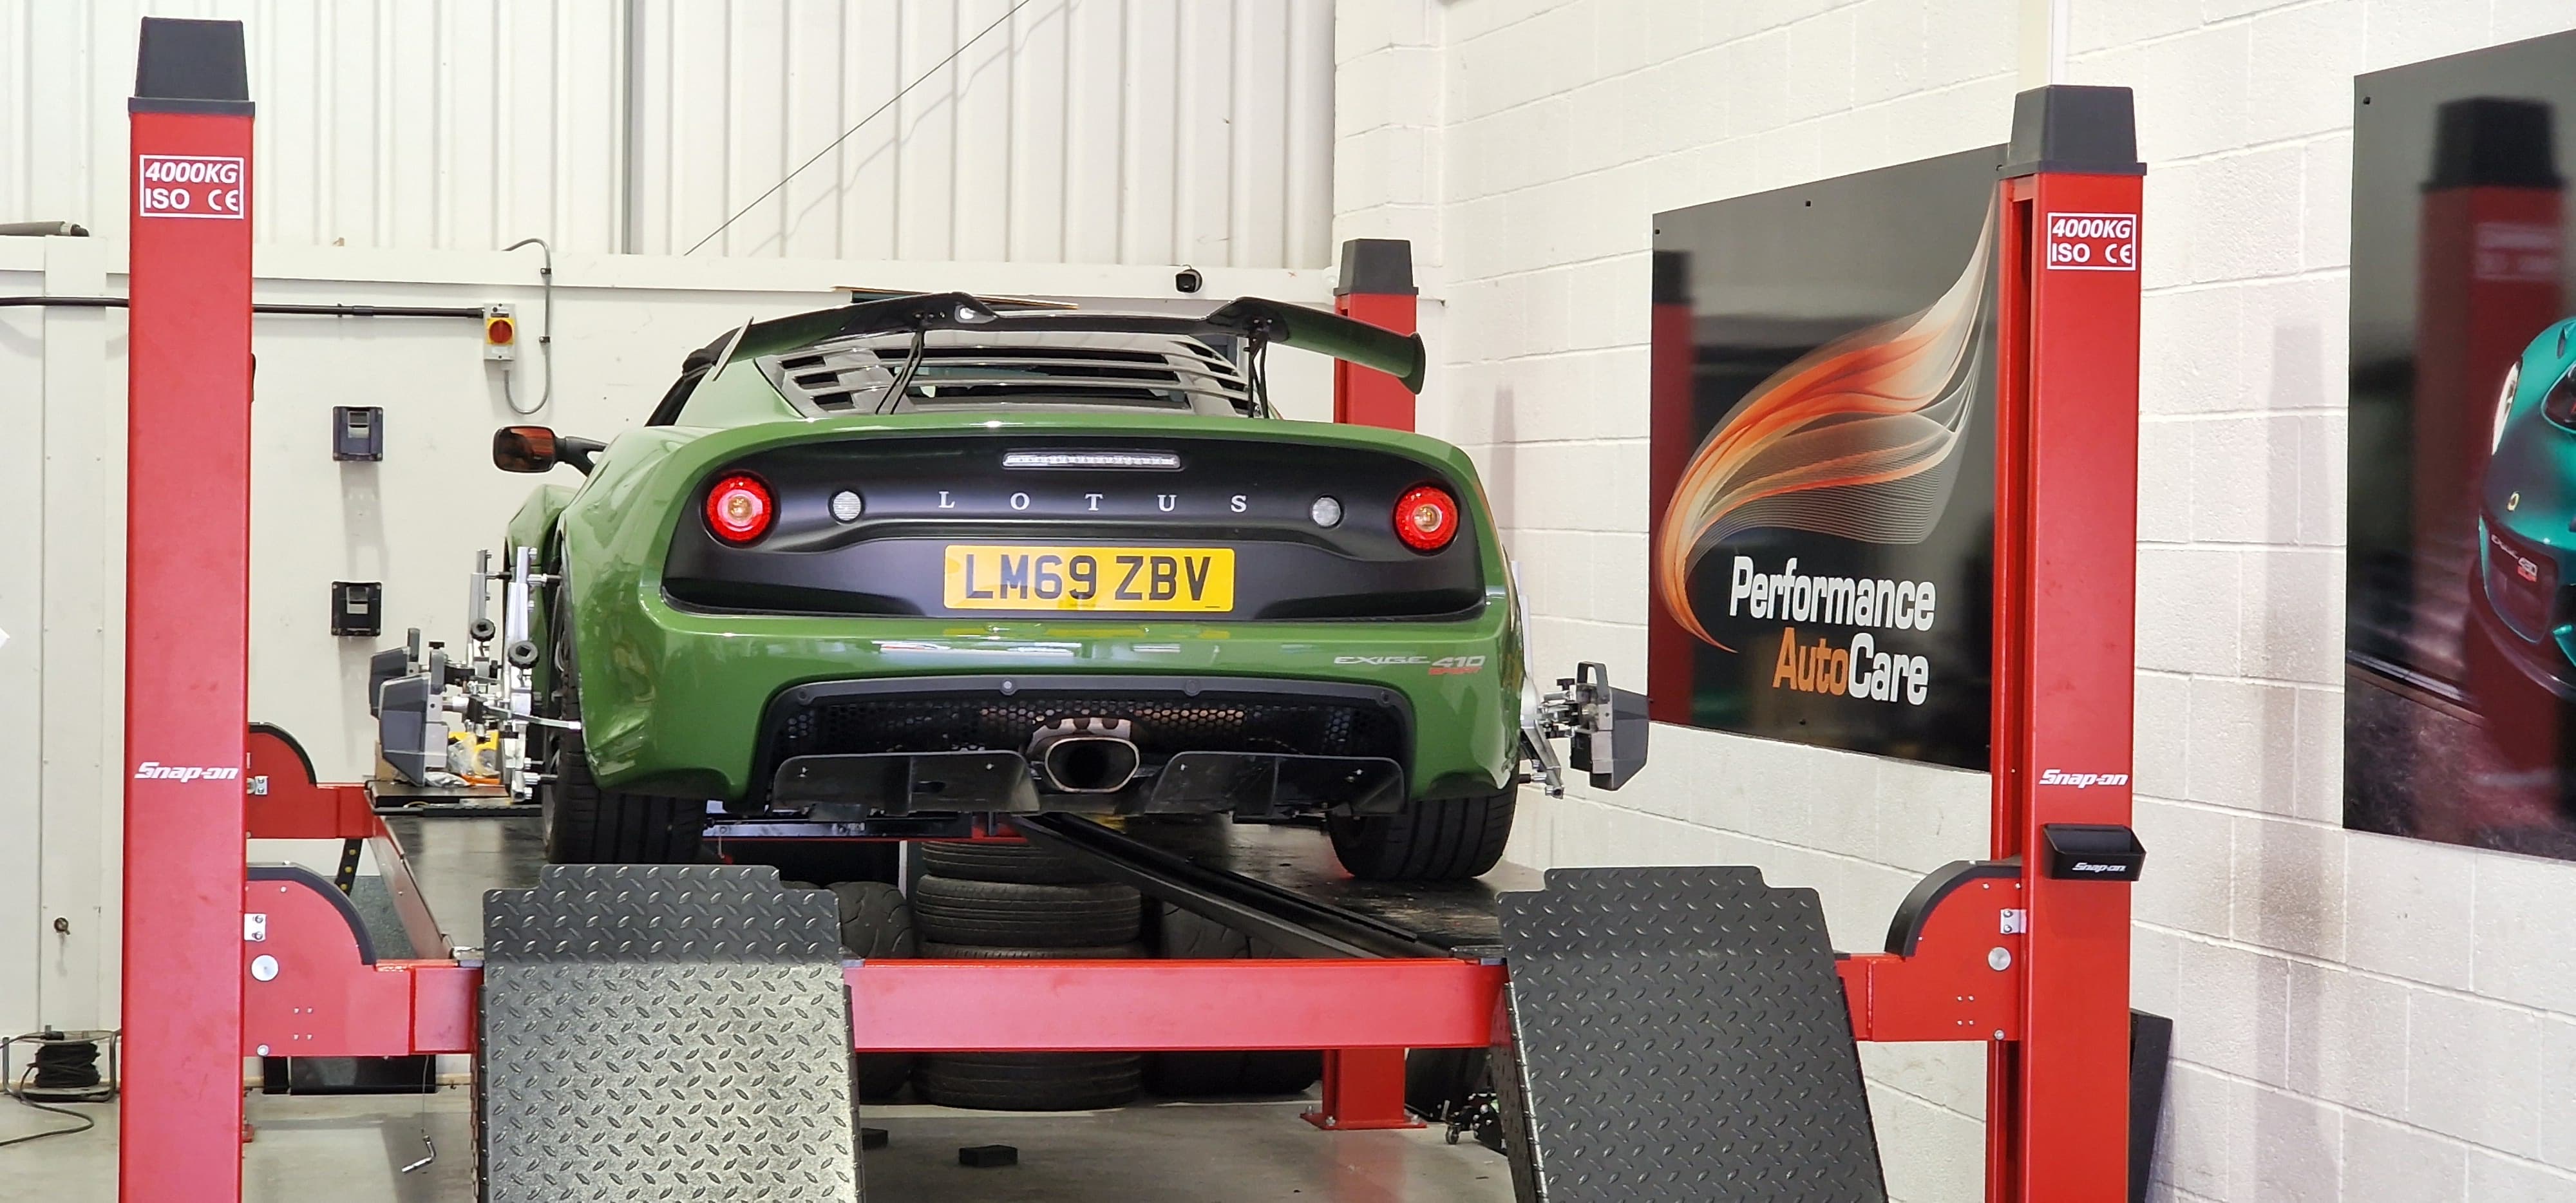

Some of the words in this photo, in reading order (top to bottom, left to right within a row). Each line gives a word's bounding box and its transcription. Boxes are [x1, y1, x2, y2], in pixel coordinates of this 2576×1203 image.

[146, 162, 238, 184] 4000KG
[145, 187, 190, 210] ISO
[2052, 219, 2132, 239] 4000KG
[2051, 242, 2091, 263] ISO
[938, 491, 1247, 513] LOTUS
[965, 554, 1098, 600] LM69
[1115, 556, 1212, 601] ZBV
[1729, 556, 1937, 631] Performance
[1334, 656, 1430, 665] EXIGE
[1432, 656, 1486, 667] 410
[1772, 627, 1929, 706] AutoCare
[134, 762, 239, 783] Snap-on
[2039, 769, 2128, 789] Snap-on
[2072, 862, 2126, 873] Snap-on
